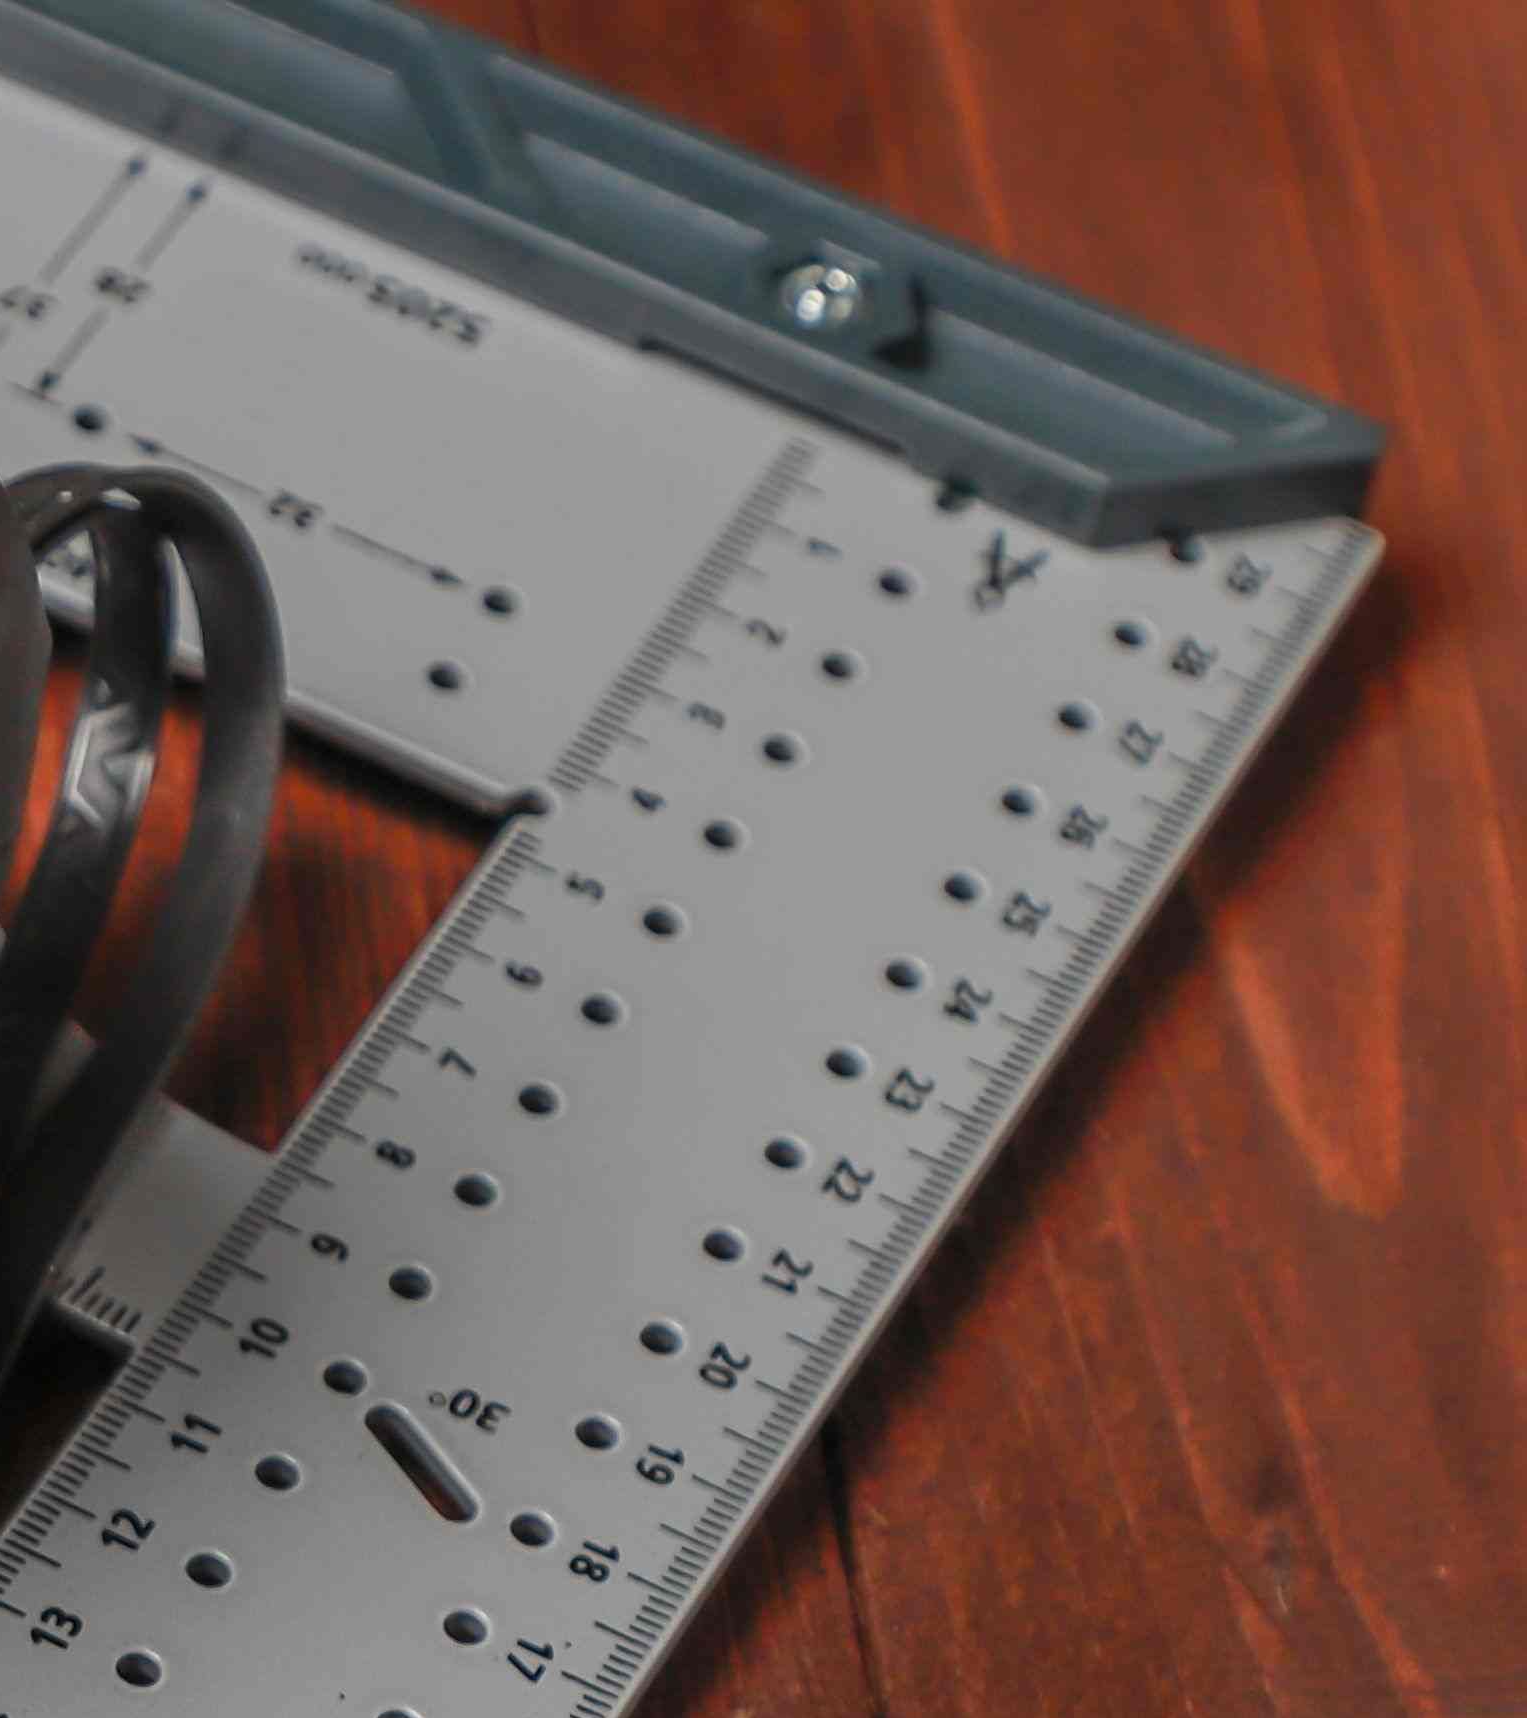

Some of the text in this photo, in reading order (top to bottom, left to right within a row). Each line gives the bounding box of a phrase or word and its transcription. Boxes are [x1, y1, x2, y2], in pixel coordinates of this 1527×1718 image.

[1117, 721, 1164, 766] 27
[1058, 804, 1107, 850] 26
[1001, 891, 1052, 938] 25
[943, 978, 993, 1023] 24
[438, 1047, 476, 1076] 7
[883, 1068, 934, 1113] 23
[375, 1141, 415, 1169] 8
[821, 1158, 873, 1203] 22
[310, 1234, 348, 1261] 9
[761, 1249, 813, 1294] 21
[238, 1318, 289, 1358] 10
[698, 1342, 751, 1390] 20
[428, 1389, 509, 1431] 30°
[170, 1414, 221, 1454] 11
[635, 1445, 684, 1485] 19
[101, 1509, 155, 1551] 12
[568, 1542, 620, 1583] 18
[30, 1606, 82, 1649] 13
[507, 1639, 554, 1683] 17
